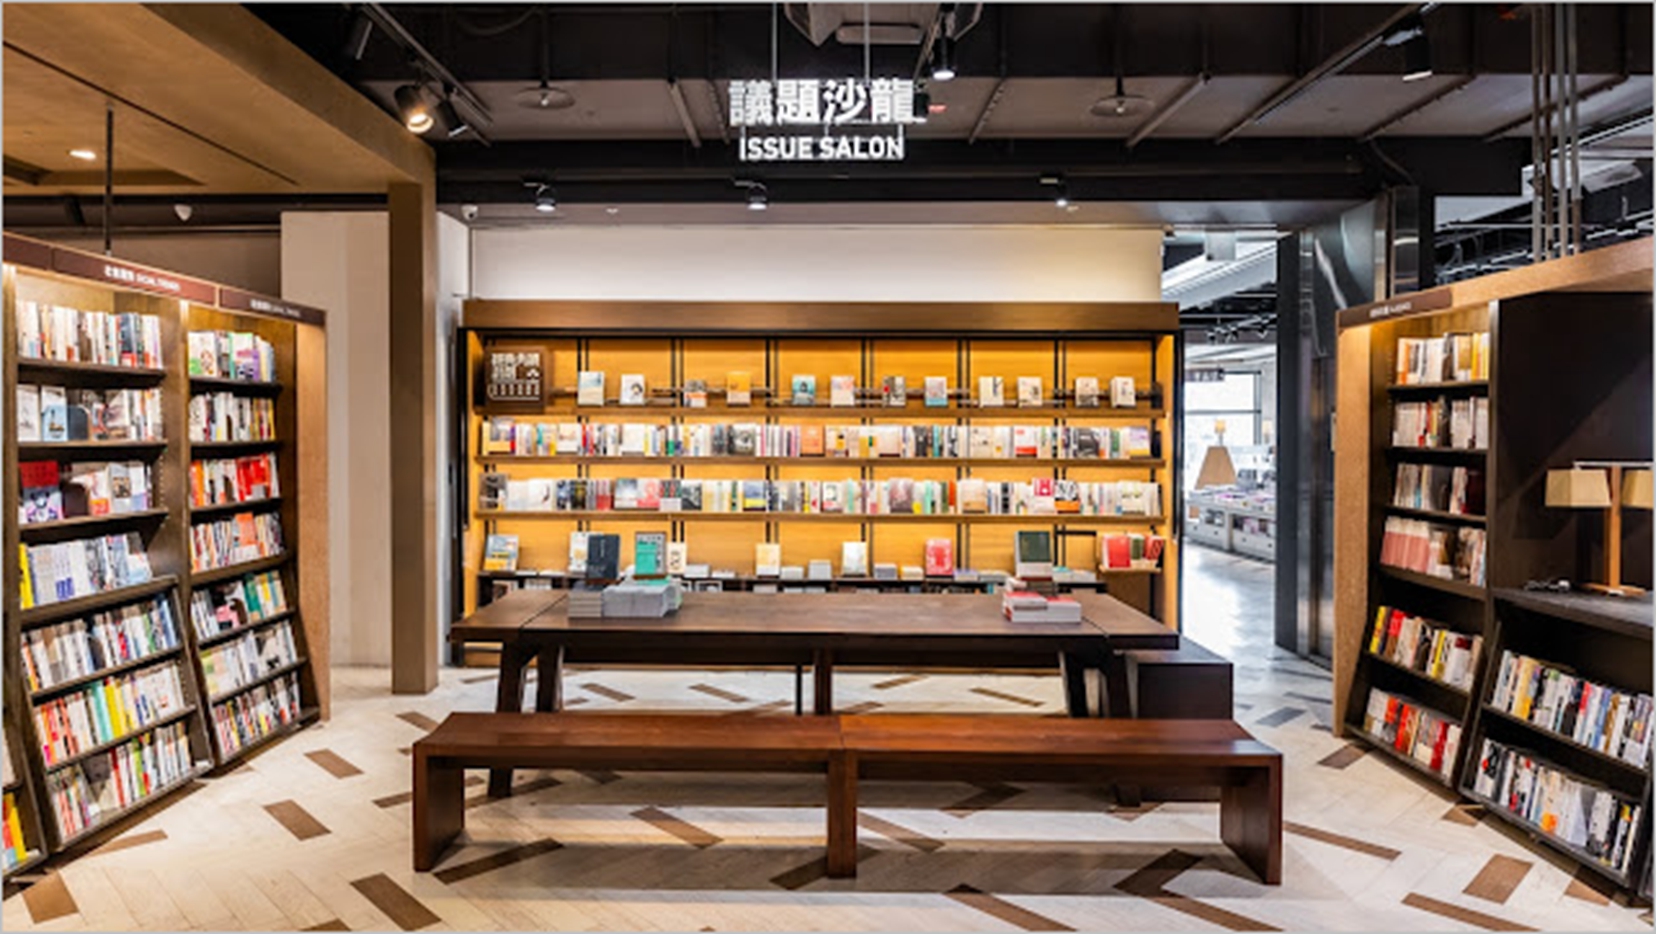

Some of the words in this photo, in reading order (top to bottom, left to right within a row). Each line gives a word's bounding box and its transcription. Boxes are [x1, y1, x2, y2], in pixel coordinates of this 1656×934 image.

[729, 78, 914, 126] 議題沙龍
[739, 137, 813, 161] ISSUE
[819, 136, 904, 161] SALON
